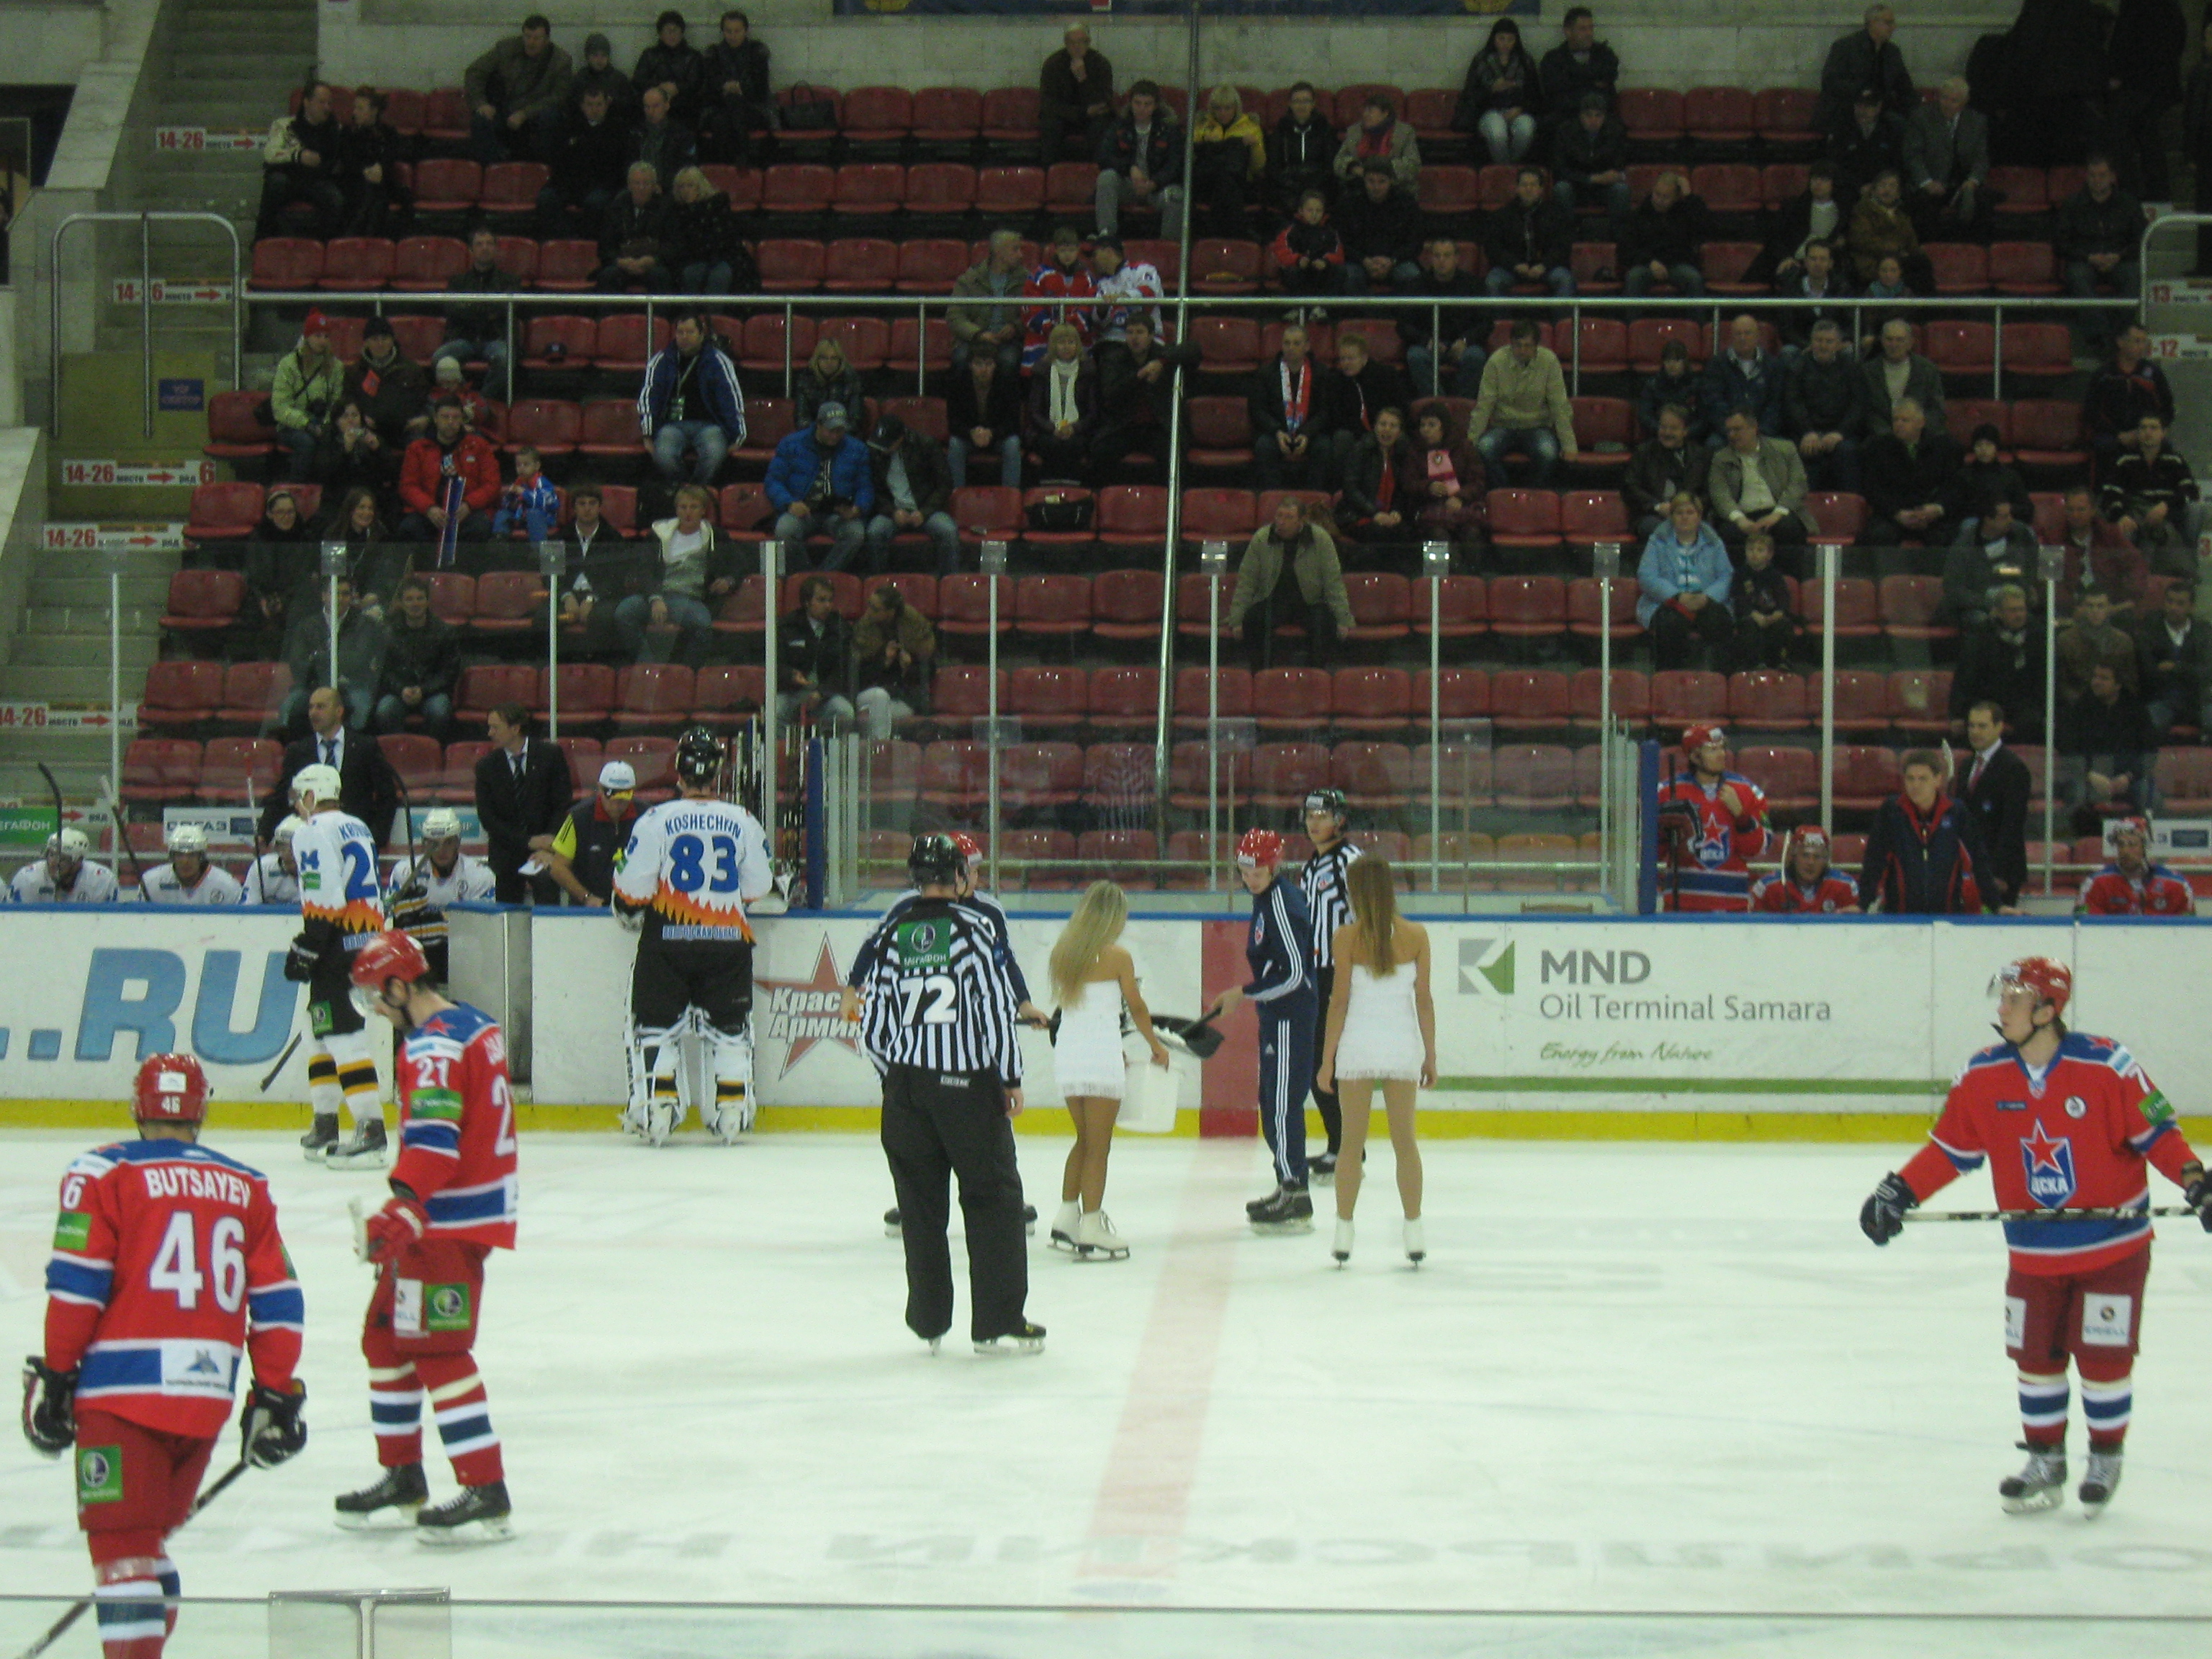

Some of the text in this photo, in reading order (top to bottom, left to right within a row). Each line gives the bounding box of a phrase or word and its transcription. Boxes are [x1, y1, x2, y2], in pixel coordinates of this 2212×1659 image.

[67, 464, 114, 483] 14-26
[199, 460, 215, 484] 6
[48, 529, 96, 547] 14-26
[0, 706, 47, 726] 4-26
[670, 834, 739, 893] 83
[1540, 950, 1651, 984] MND
[900, 974, 957, 1026] 72
[1540, 993, 1831, 1021] Oil Terminal Samara
[1540, 1041, 1599, 1068] Energy
[144, 1166, 252, 1210] BUTSAYEV
[148, 1209, 248, 1314] 46
